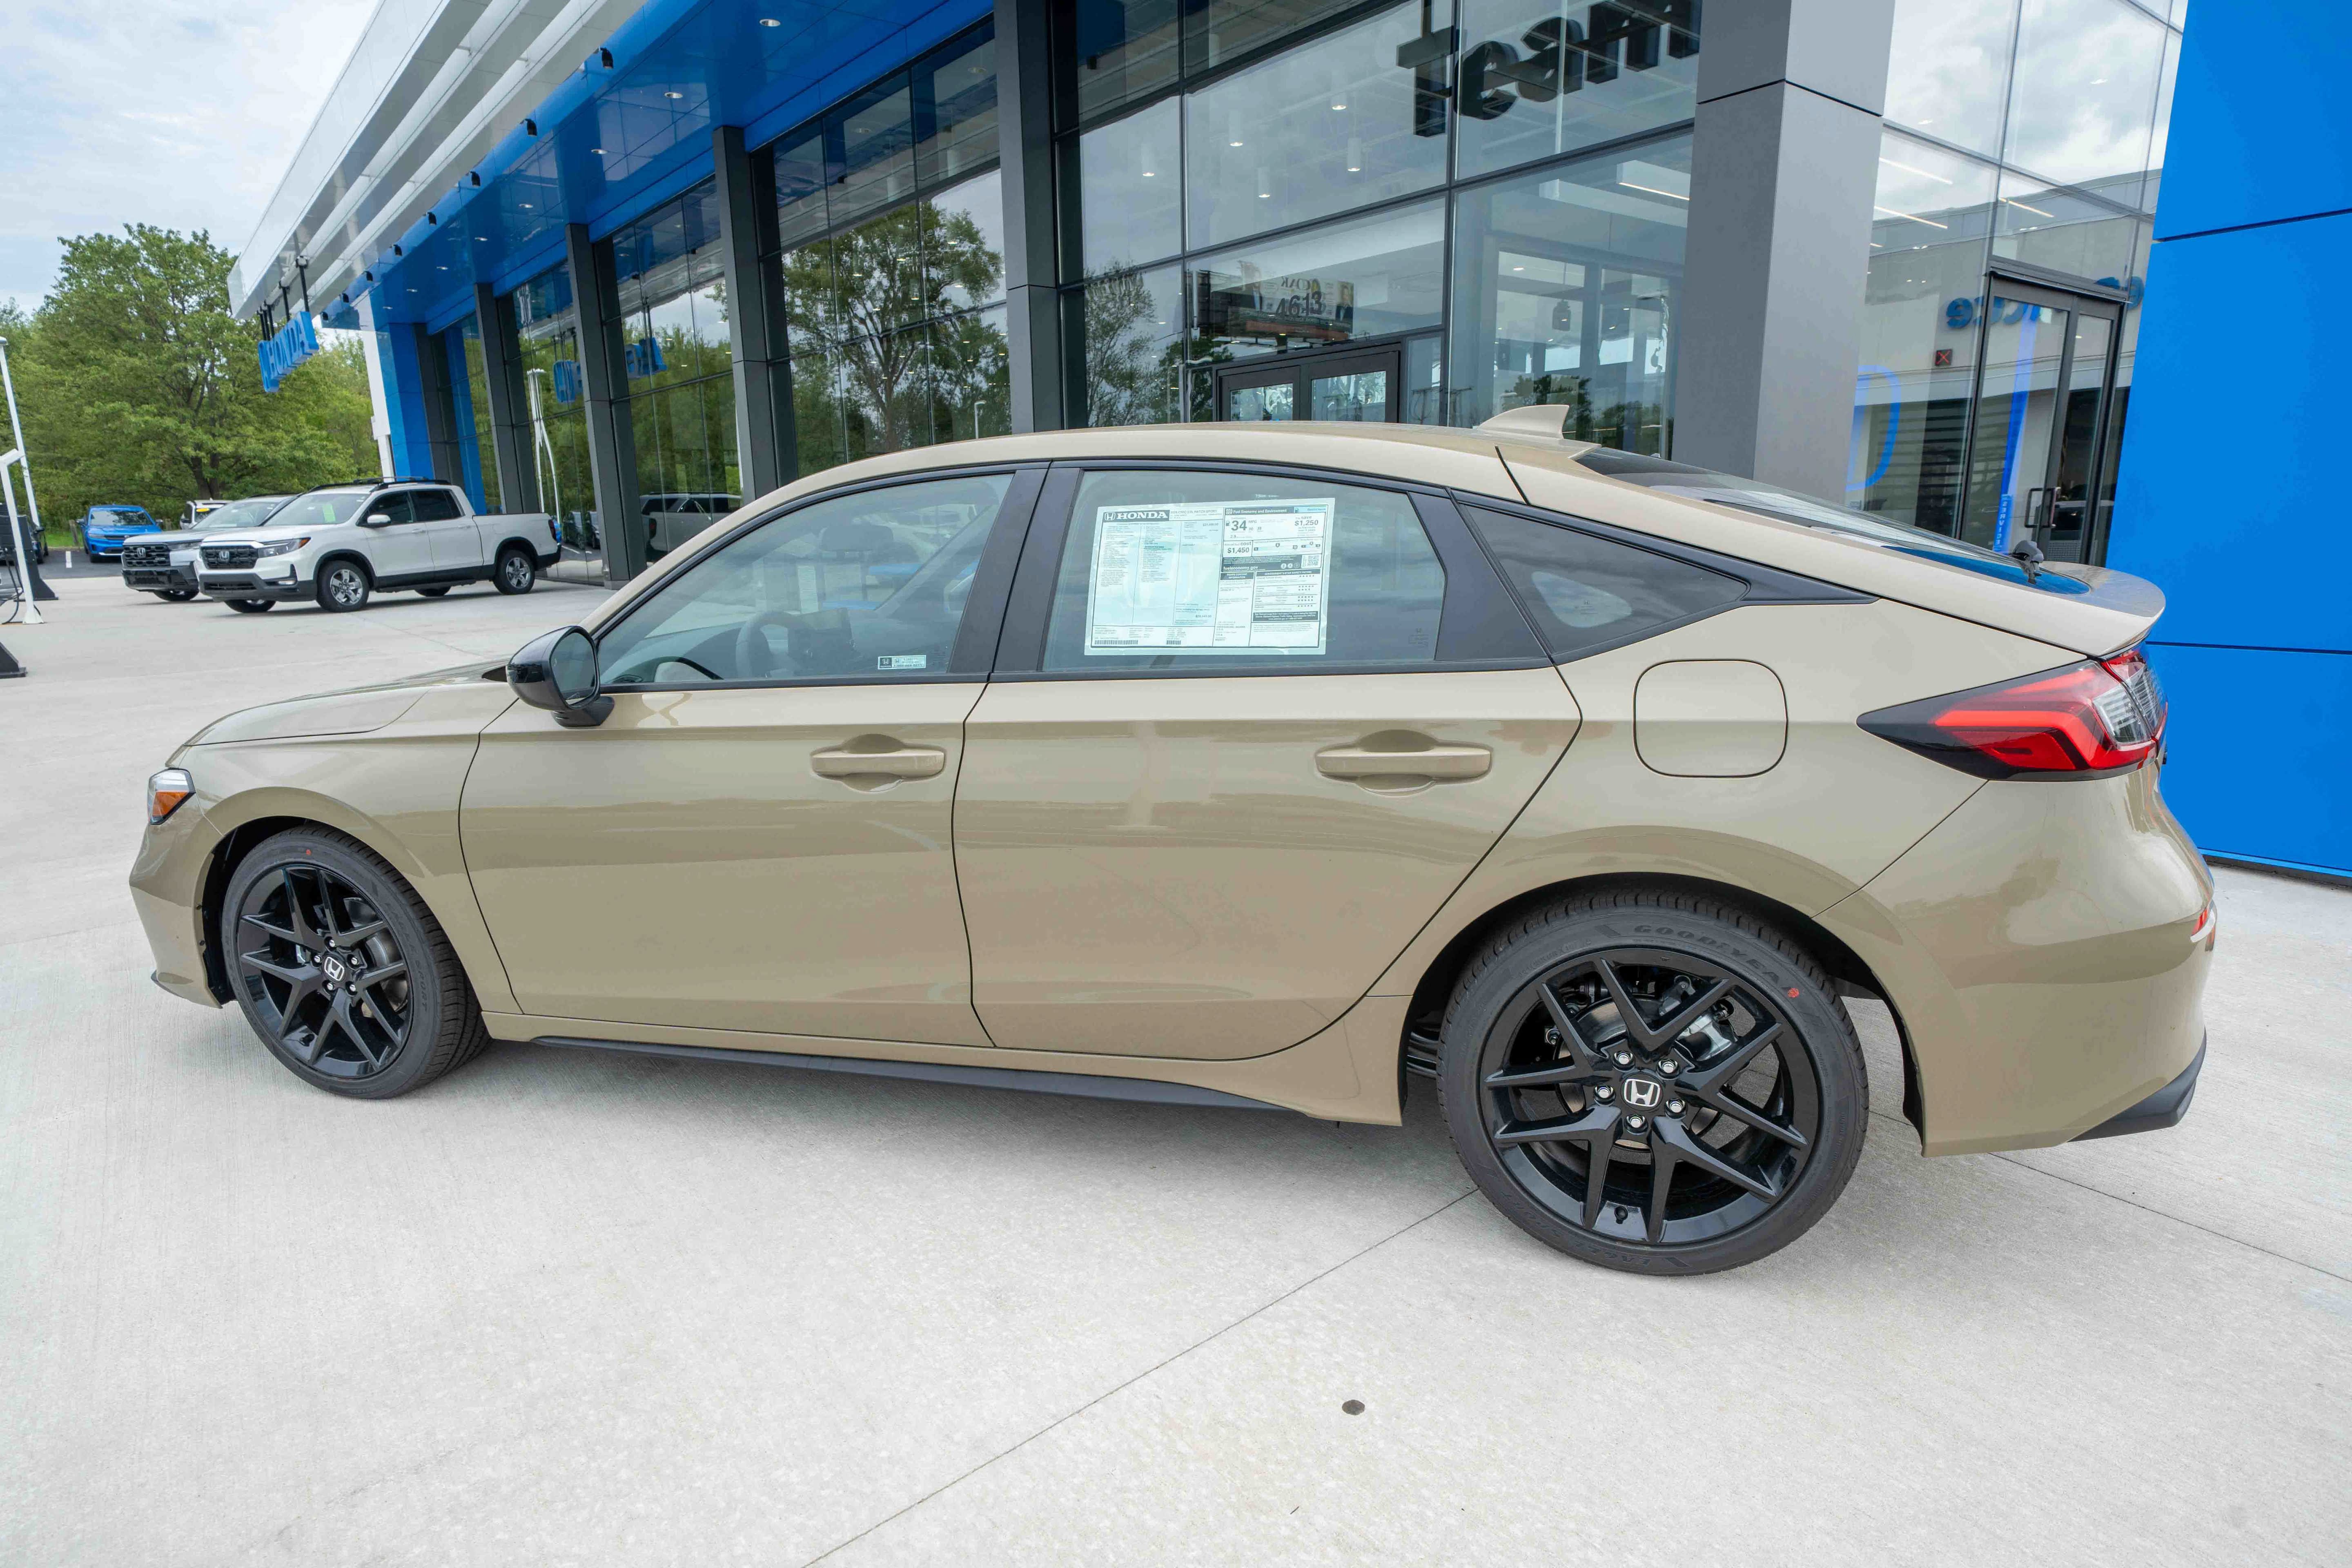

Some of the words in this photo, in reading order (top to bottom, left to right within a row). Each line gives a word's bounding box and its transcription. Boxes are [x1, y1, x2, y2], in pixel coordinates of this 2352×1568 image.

[1276, 290, 1322, 316] 4613
[1231, 520, 1247, 531] 34
[1635, 924, 1799, 997] GOODYEA
